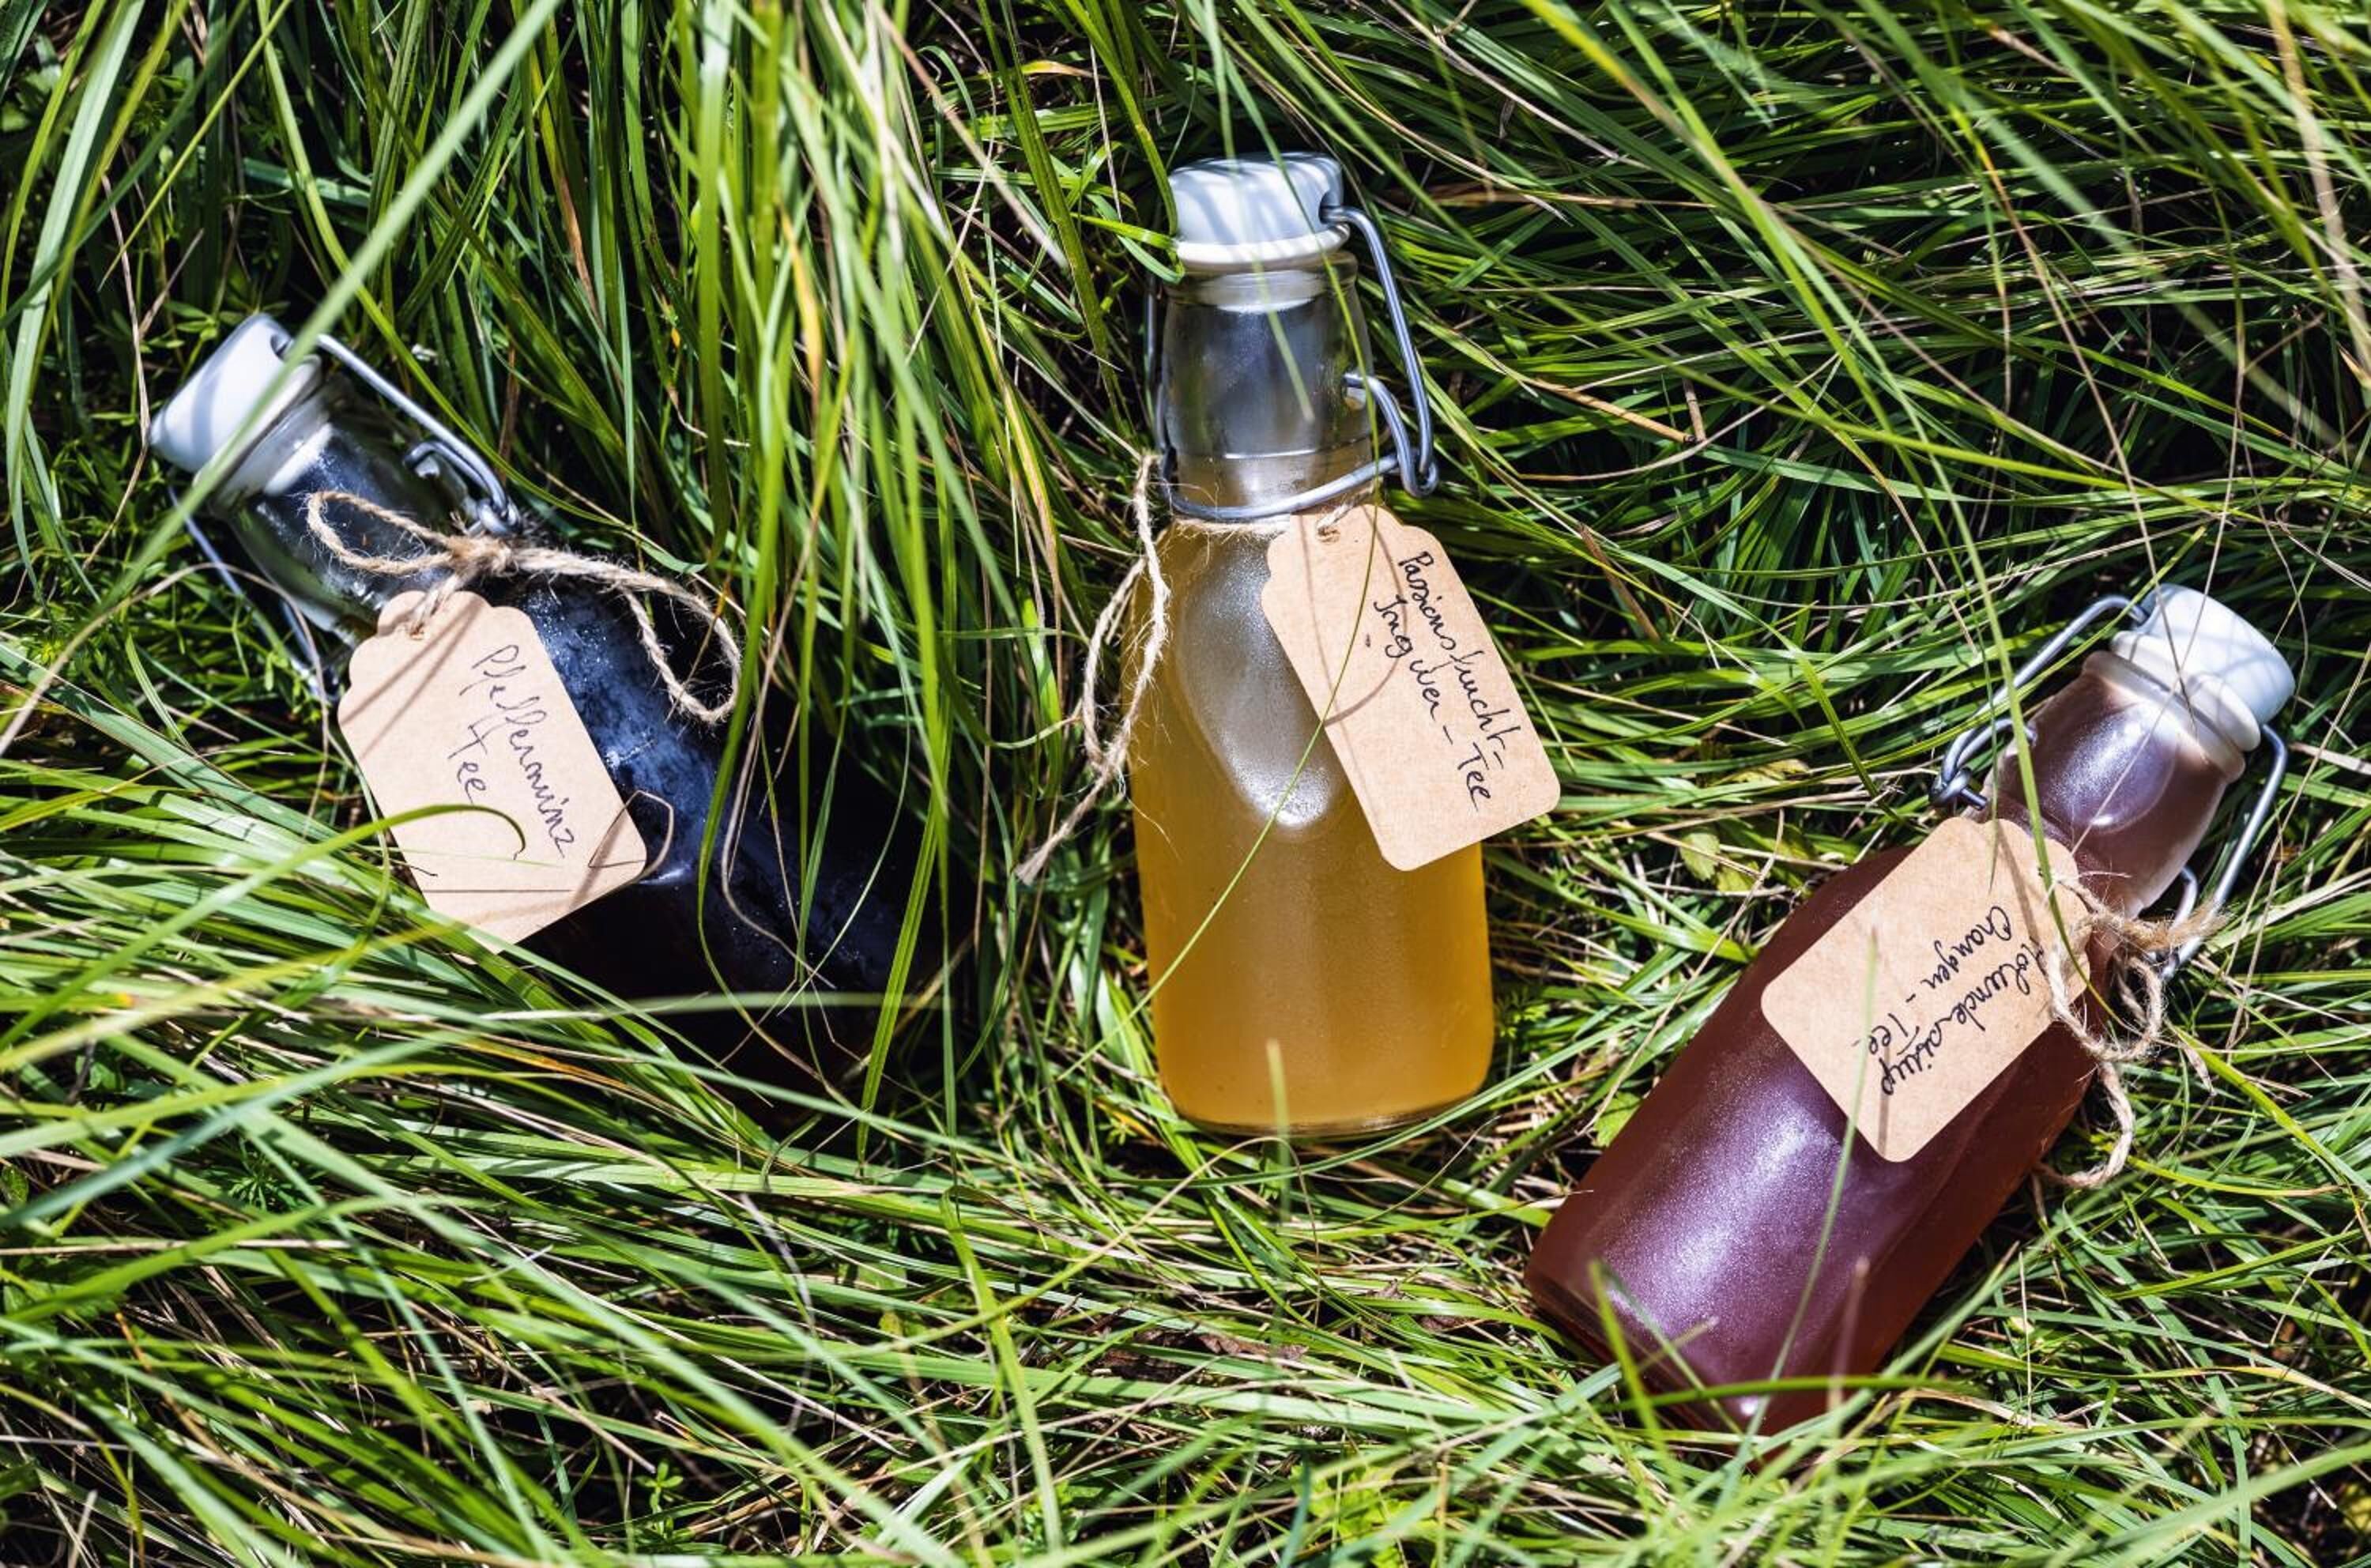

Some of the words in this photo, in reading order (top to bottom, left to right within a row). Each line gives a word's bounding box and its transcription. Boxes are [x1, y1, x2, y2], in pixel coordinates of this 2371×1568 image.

[447, 722, 488, 805] Tee
[459, 644, 575, 859] Pfefferminz
[1457, 741, 1491, 812] Tee
[1850, 1012, 1920, 1056] Tee
